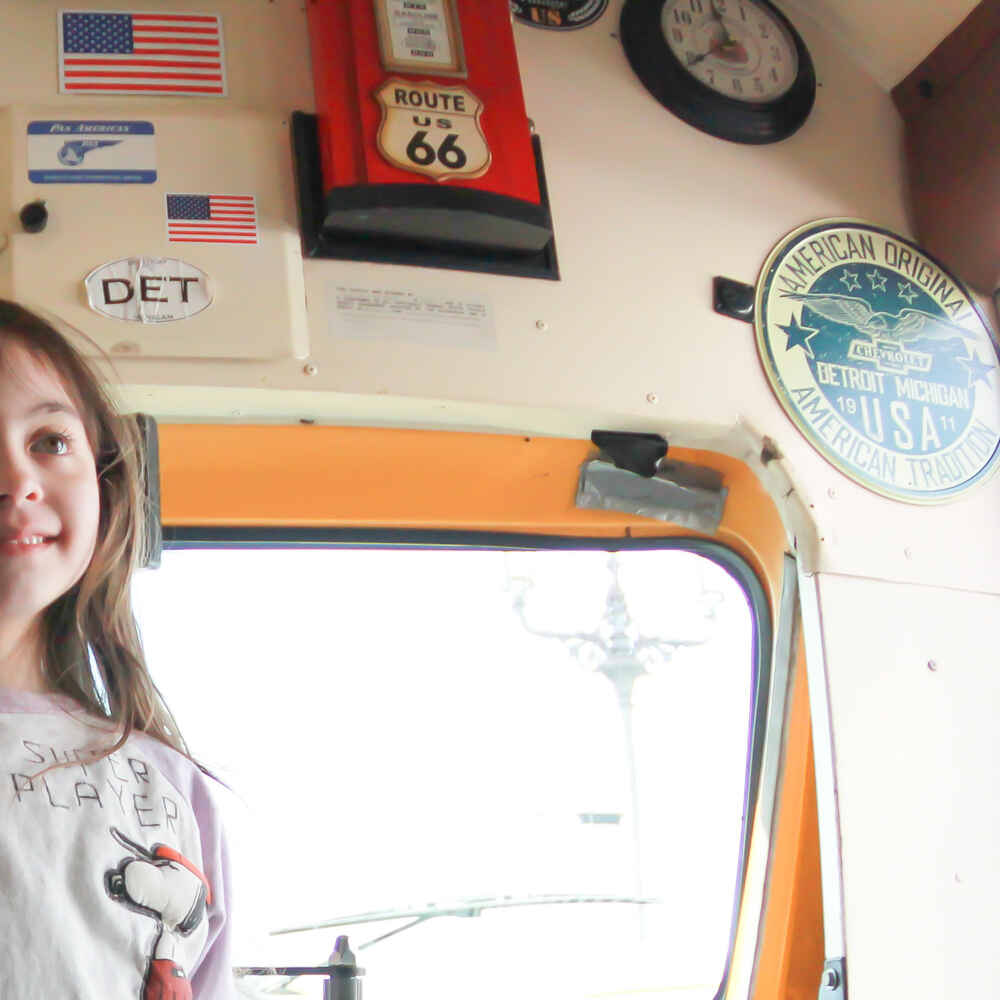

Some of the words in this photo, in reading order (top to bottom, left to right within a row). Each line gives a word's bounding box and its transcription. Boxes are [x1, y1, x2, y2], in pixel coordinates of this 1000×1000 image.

[394, 87, 465, 112] ROUTE
[406, 130, 467, 169] 66
[101, 275, 199, 304] DET
[779, 233, 877, 295] AMERICAN
[816, 361, 885, 395] DETROIT
[894, 374, 970, 409] MICHIGAN
[791, 386, 897, 484] AMERICAN
[904, 417, 1000, 488] TRADITION
[836, 395, 857, 415] 19
[860, 394, 941, 451] USA
[939, 414, 956, 433] 11
[10, 772, 179, 834] PLAYER
